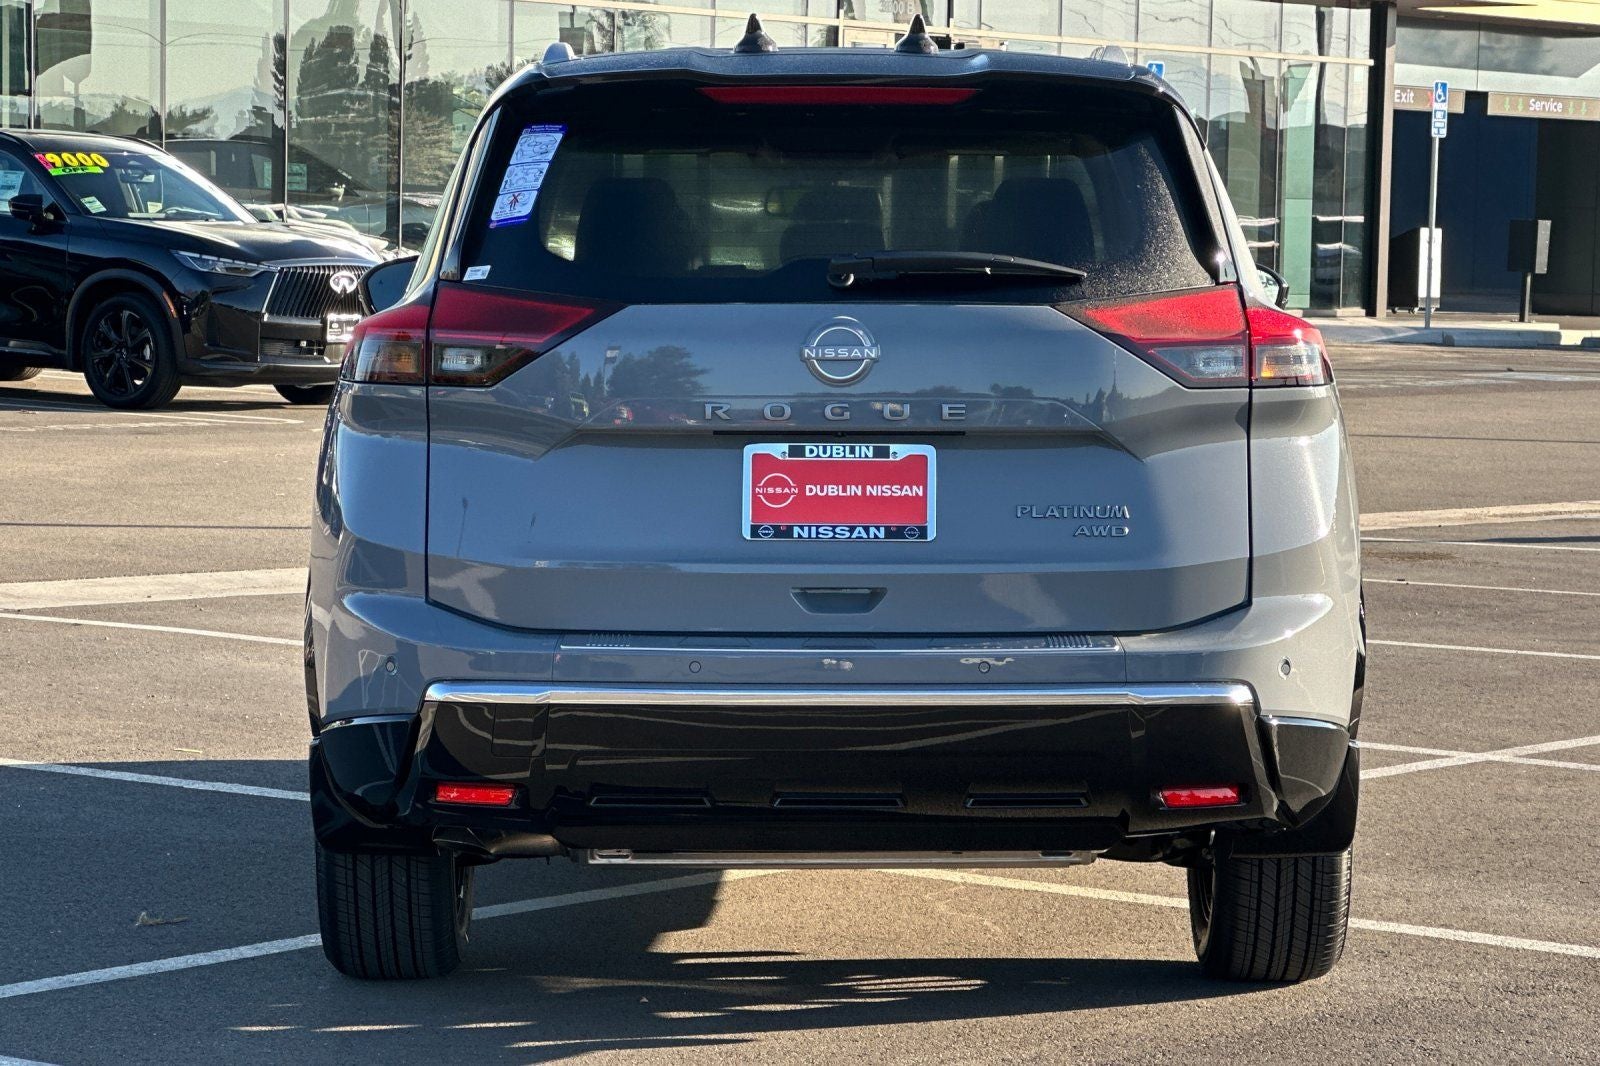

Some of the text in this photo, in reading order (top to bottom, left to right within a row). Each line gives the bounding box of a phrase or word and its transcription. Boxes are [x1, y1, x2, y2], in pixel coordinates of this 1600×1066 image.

[1394, 90, 1414, 104] Exit
[1529, 98, 1563, 112] Service
[45, 152, 109, 168] 9000
[804, 348, 877, 358] NISSAN
[704, 402, 967, 421] ROGUE
[805, 445, 873, 458] DUBLIN
[755, 486, 799, 494] NISSAN
[805, 484, 923, 497] DUBLIN NISSAN
[1016, 505, 1130, 519] PLATINUM
[792, 526, 885, 539] NISSAN
[1074, 524, 1130, 537] AWD
